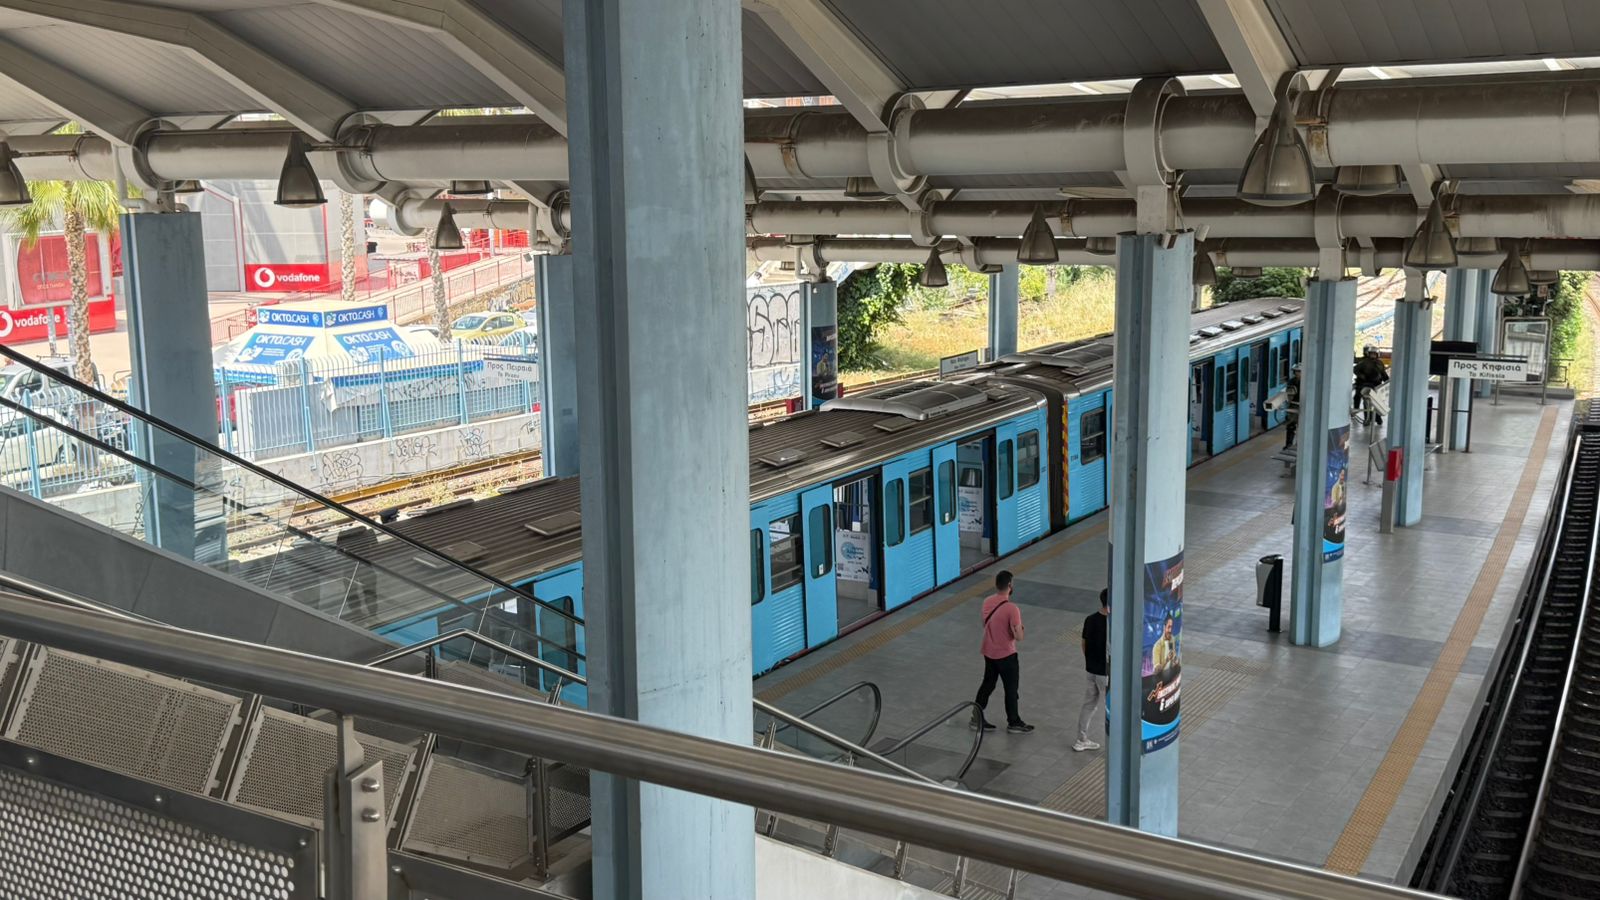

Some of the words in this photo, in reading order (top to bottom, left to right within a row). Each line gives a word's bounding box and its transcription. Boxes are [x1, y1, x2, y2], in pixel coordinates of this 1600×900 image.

[276, 273, 320, 282] vodafone
[15, 314, 60, 327] vodafoe
[487, 361, 504, 371] Προς
[1453, 361, 1478, 371] Προς
[1481, 362, 1521, 372] Κηφισιά
